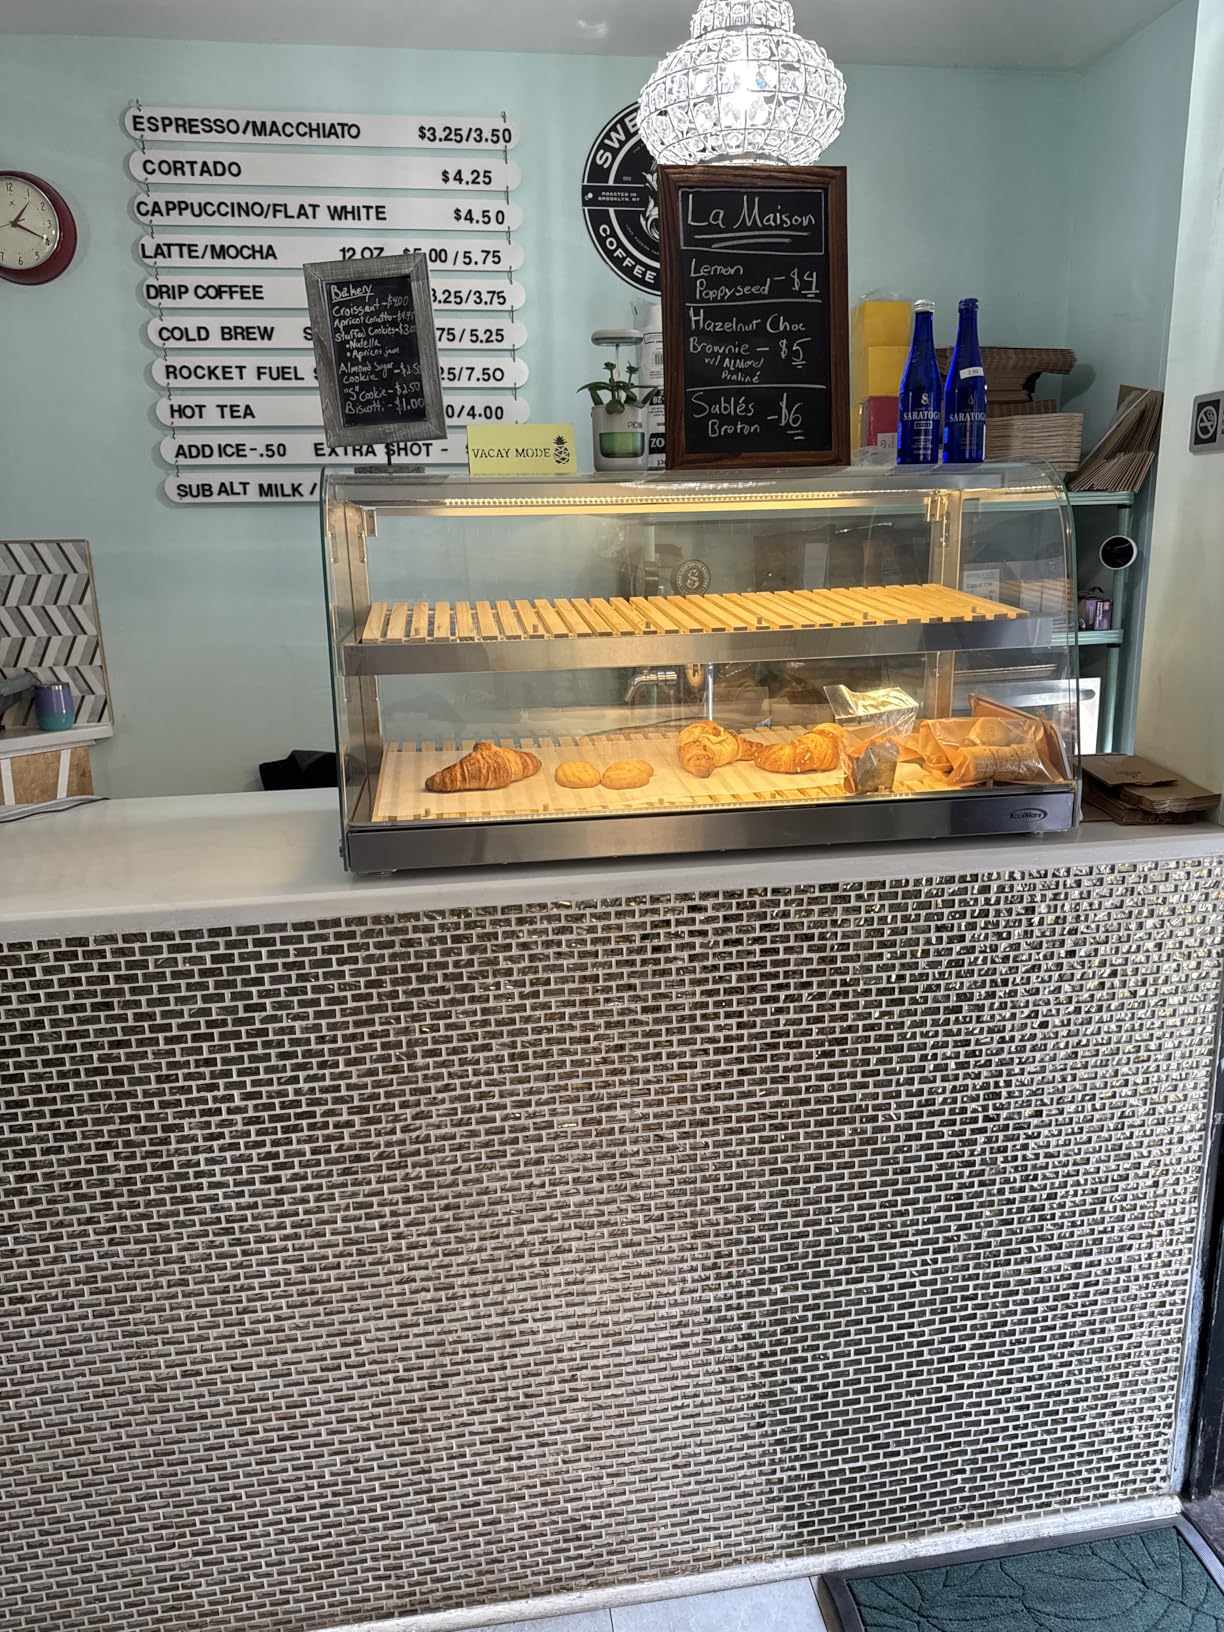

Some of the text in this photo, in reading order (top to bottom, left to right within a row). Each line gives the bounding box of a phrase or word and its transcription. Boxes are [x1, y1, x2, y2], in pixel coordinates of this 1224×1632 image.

[132, 114, 512, 144] ESPRESSO/MACCHIATO $3.25/3.50
[142, 159, 492, 185] CORTADO $4.25
[136, 200, 505, 225] CAPPUCCINO/FLAT WHITE $4.50
[688, 194, 815, 228] La Maison
[140, 243, 278, 260] LATTE/MOCHA
[339, 247, 356, 260] 12
[361, 246, 385, 259] OZ
[600, 224, 656, 283] COFFEE
[690, 258, 743, 277] Lemon
[146, 284, 189, 300] DRIP
[194, 284, 264, 300] COFFEE
[330, 283, 373, 302] Bakery
[696, 278, 771, 300] Poppyseed
[332, 297, 380, 317] Croissant
[333, 316, 364, 331] Apricot
[689, 307, 806, 333] Hazelnut Choc
[158, 326, 210, 341] COLD
[220, 326, 275, 341] BREW
[435, 327, 505, 343] 75/5.25
[335, 327, 366, 342] Stuffed
[349, 337, 381, 349] Nutella
[689, 336, 750, 355] Brownie
[352, 348, 382, 361] Apricot
[165, 365, 247, 380] ROCKET
[256, 366, 305, 381] FUEL
[339, 361, 372, 374] Almond
[722, 370, 761, 383] Praliné
[170, 404, 504, 420] HOT TEA 0/4.00
[345, 400, 385, 414] Biscotti
[691, 392, 755, 418] Sablés
[949, 413, 987, 422] SARATOG
[175, 444, 213, 459] ADD
[314, 442, 377, 457] EXTRA
[385, 442, 433, 457] SHOT
[471, 448, 510, 458] VACAY
[514, 448, 551, 458] MODE
[176, 483, 213, 498] SUB
[217, 481, 250, 496] ALT
